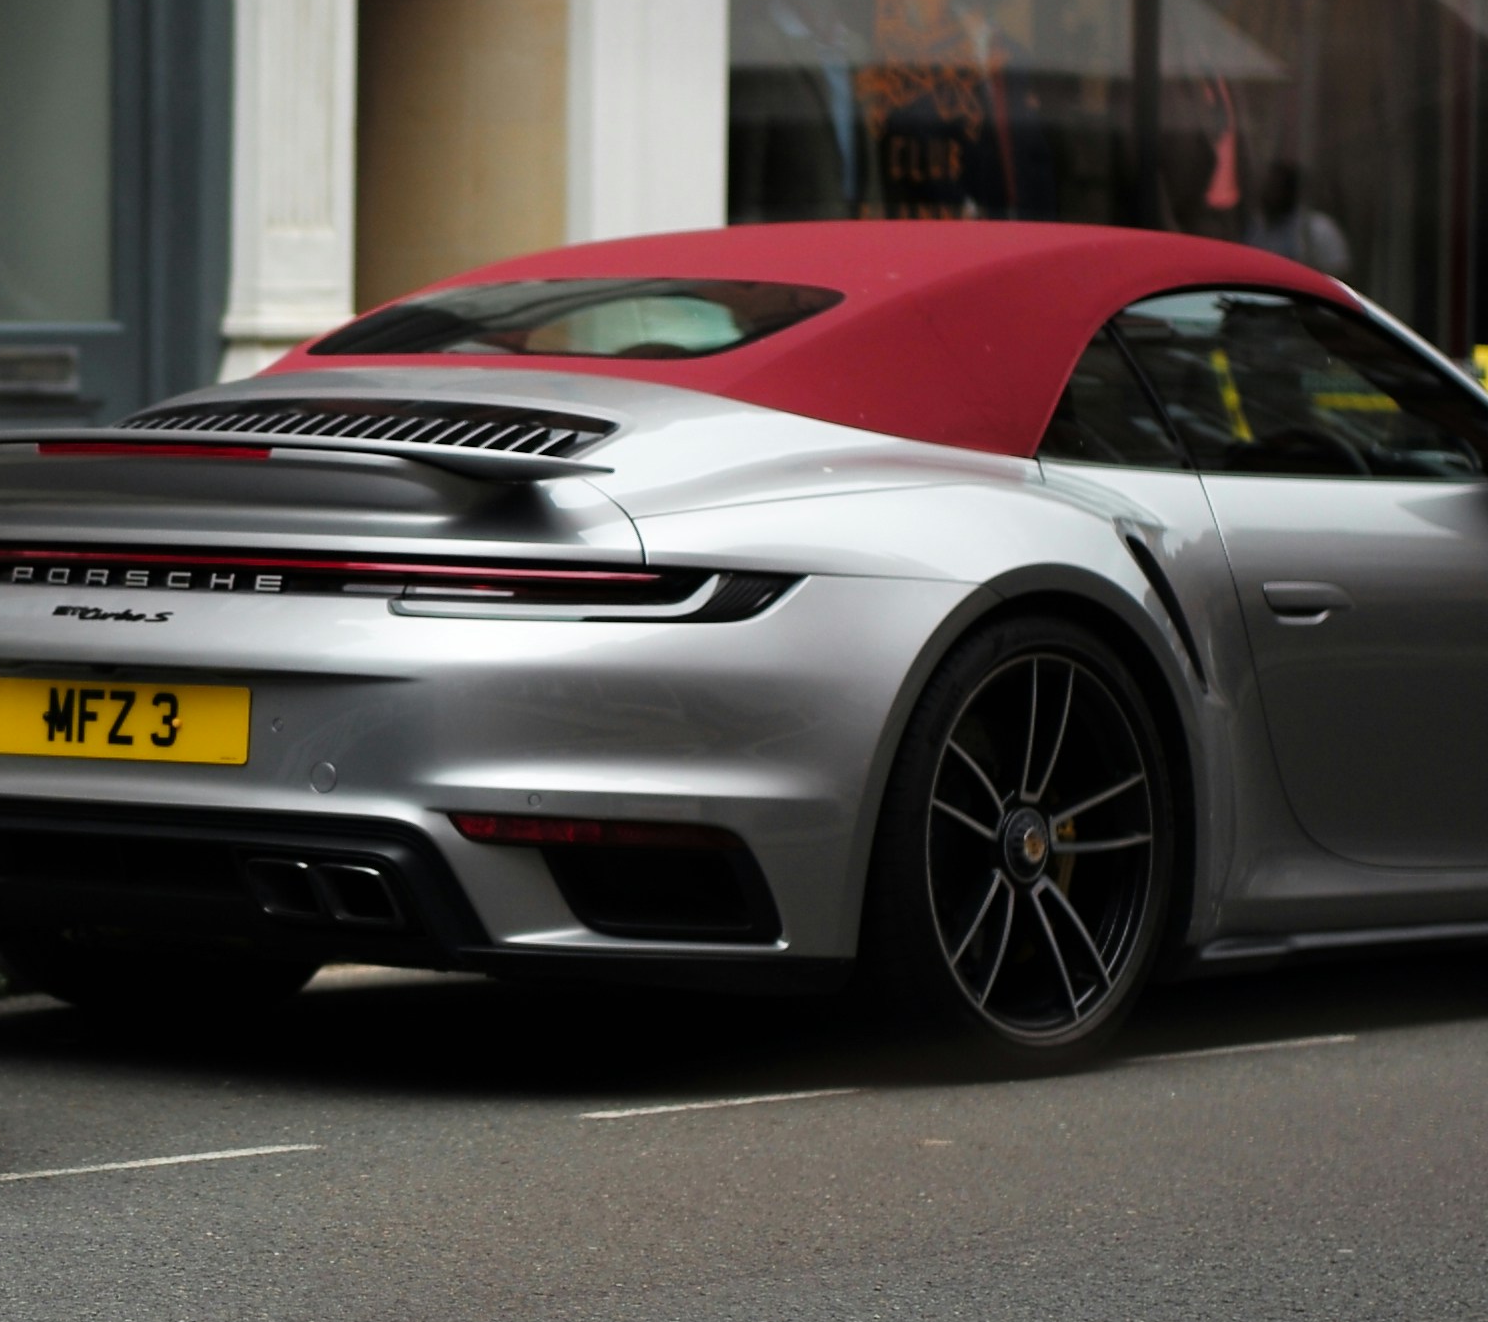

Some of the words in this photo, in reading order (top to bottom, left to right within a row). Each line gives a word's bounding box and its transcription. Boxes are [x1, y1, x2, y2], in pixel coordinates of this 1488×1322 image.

[11, 566, 284, 592] PORSCHE
[46, 687, 136, 745] MFZ
[151, 692, 180, 748] 3
